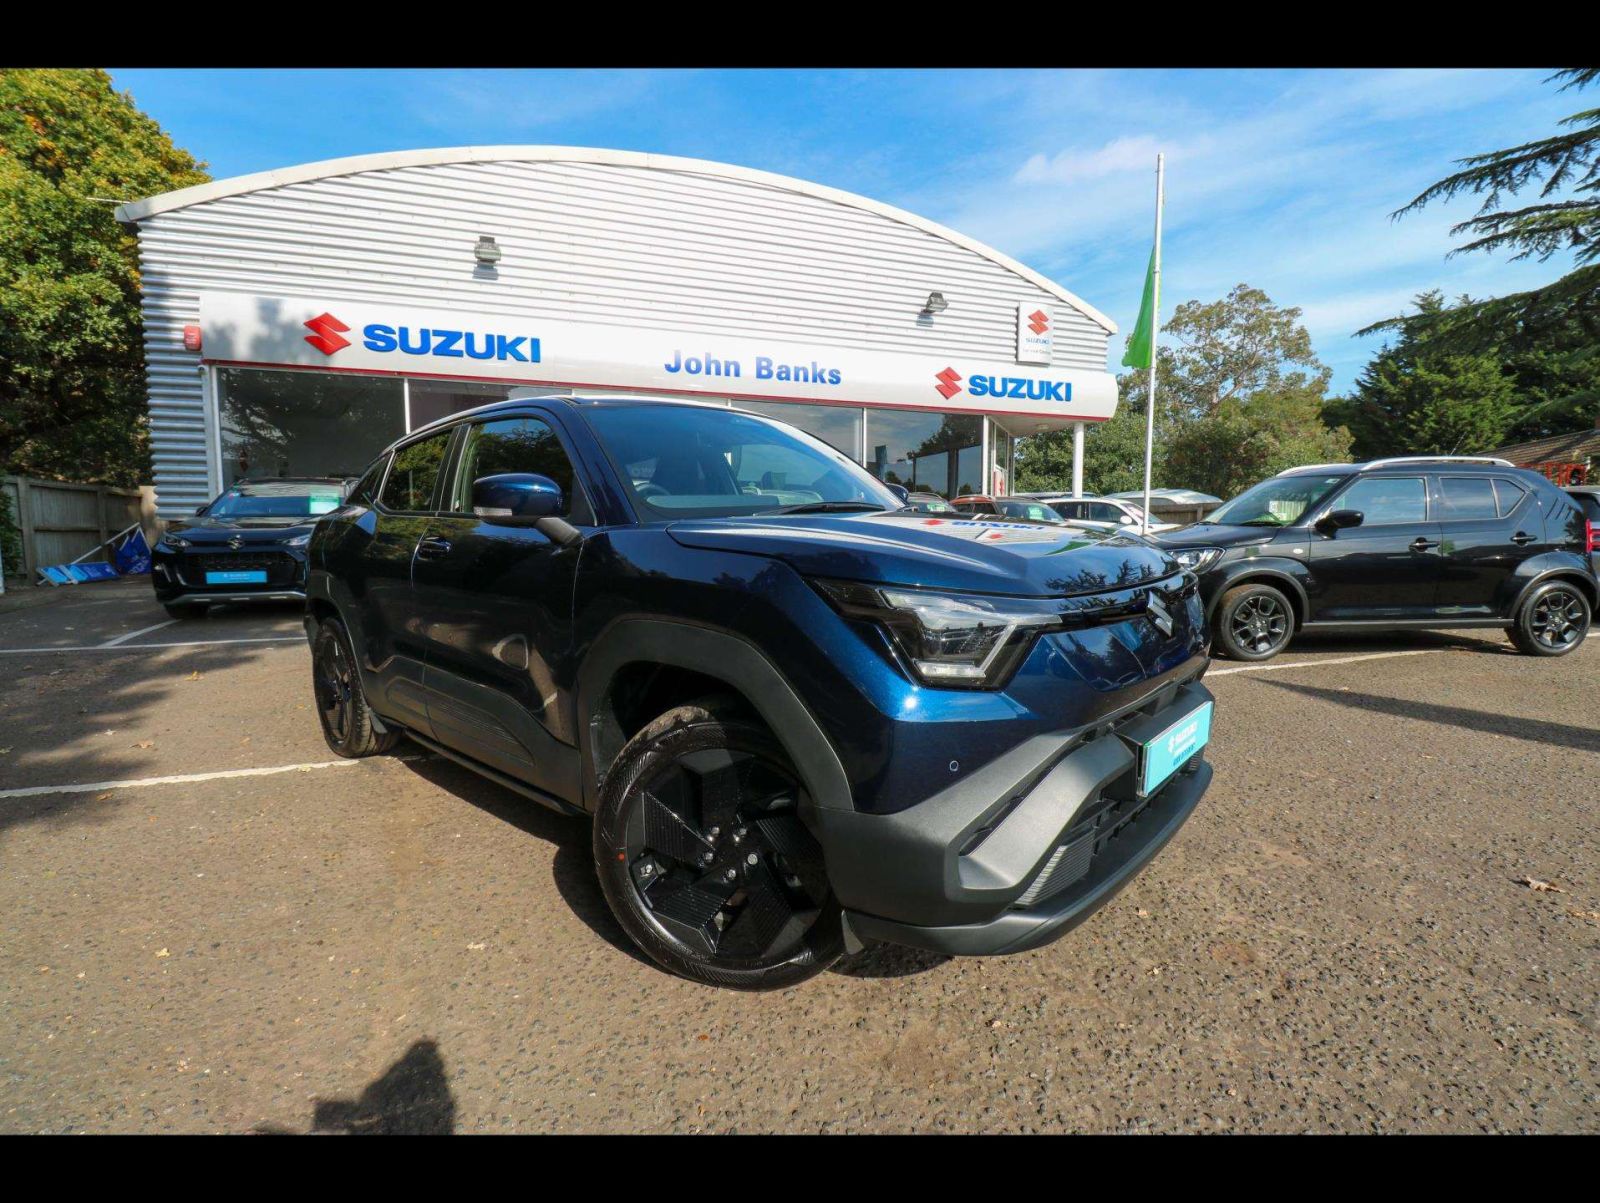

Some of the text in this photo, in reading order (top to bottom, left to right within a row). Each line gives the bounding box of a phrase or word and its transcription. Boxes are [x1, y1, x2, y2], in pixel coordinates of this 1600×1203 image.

[363, 324, 541, 363] SUZUKI
[664, 350, 842, 385] John Banks
[968, 374, 1072, 402] SUZUKI
